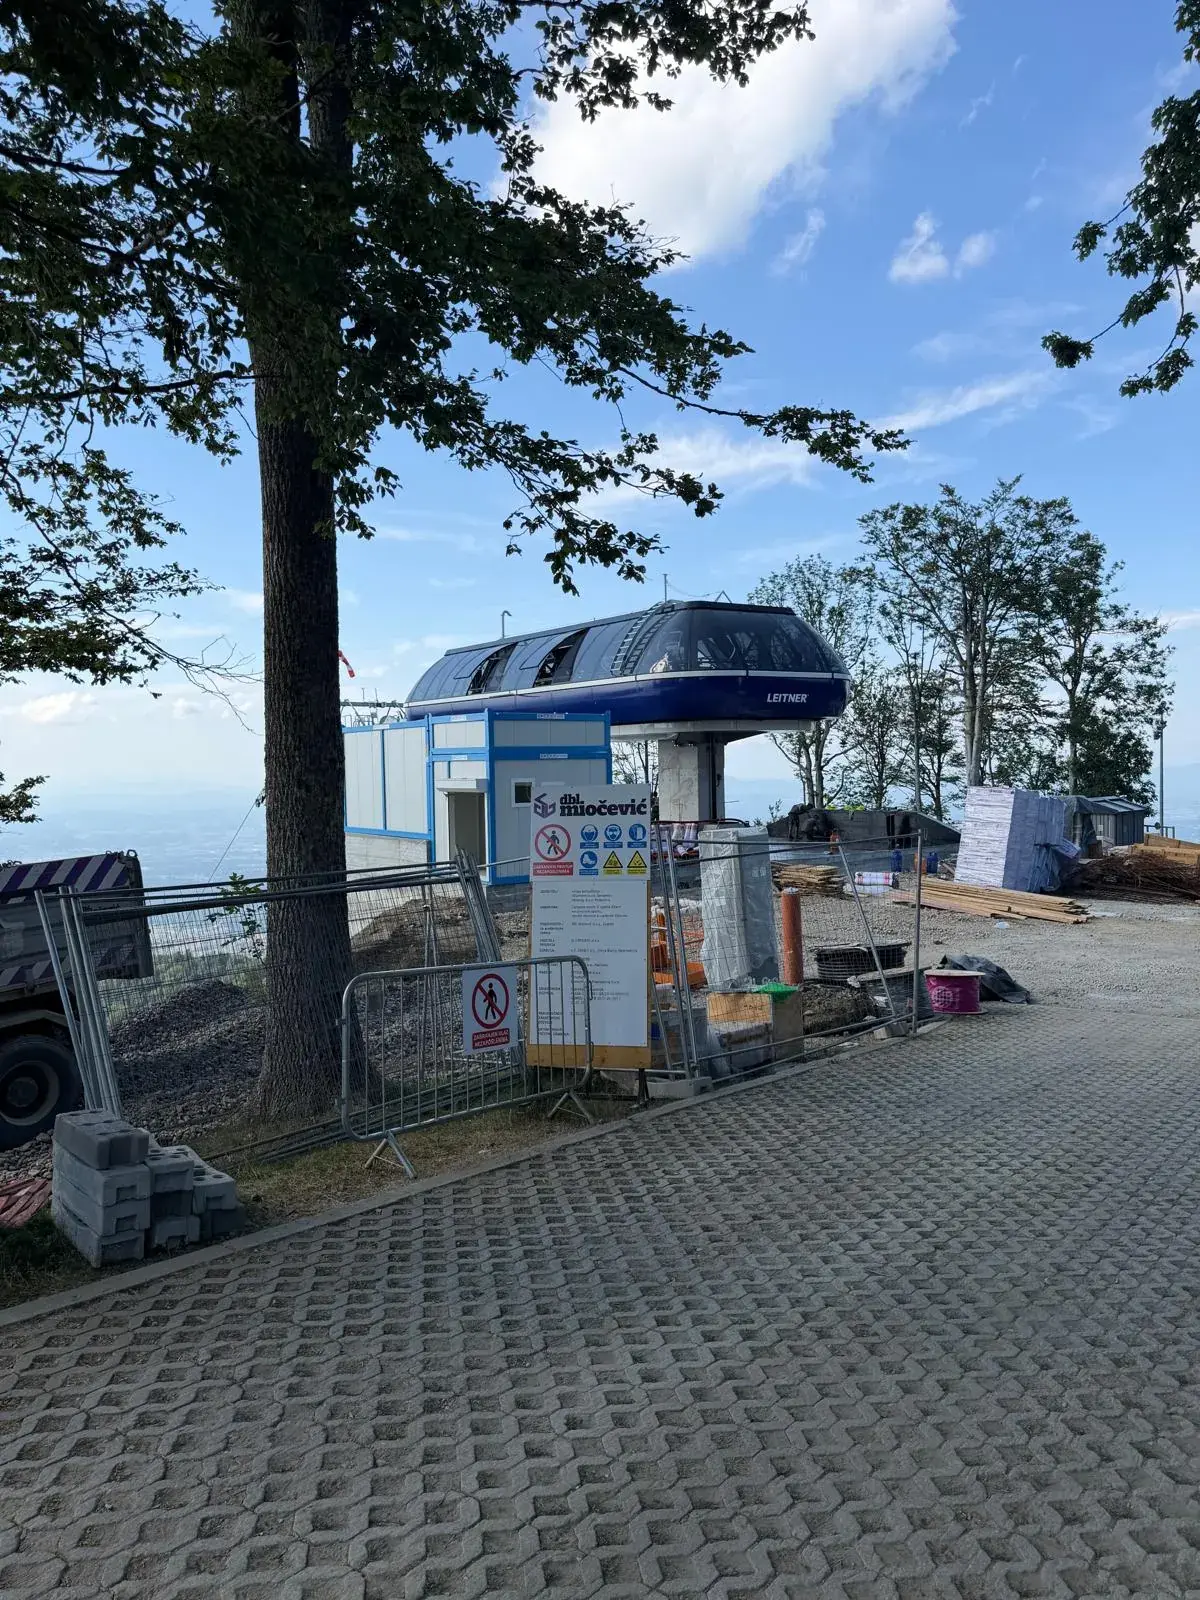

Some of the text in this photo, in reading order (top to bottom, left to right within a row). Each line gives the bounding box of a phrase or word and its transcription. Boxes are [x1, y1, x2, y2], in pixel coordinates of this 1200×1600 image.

[766, 693, 808, 703] LEITNER
[559, 793, 585, 805] dbl.
[559, 798, 648, 817] miočević
